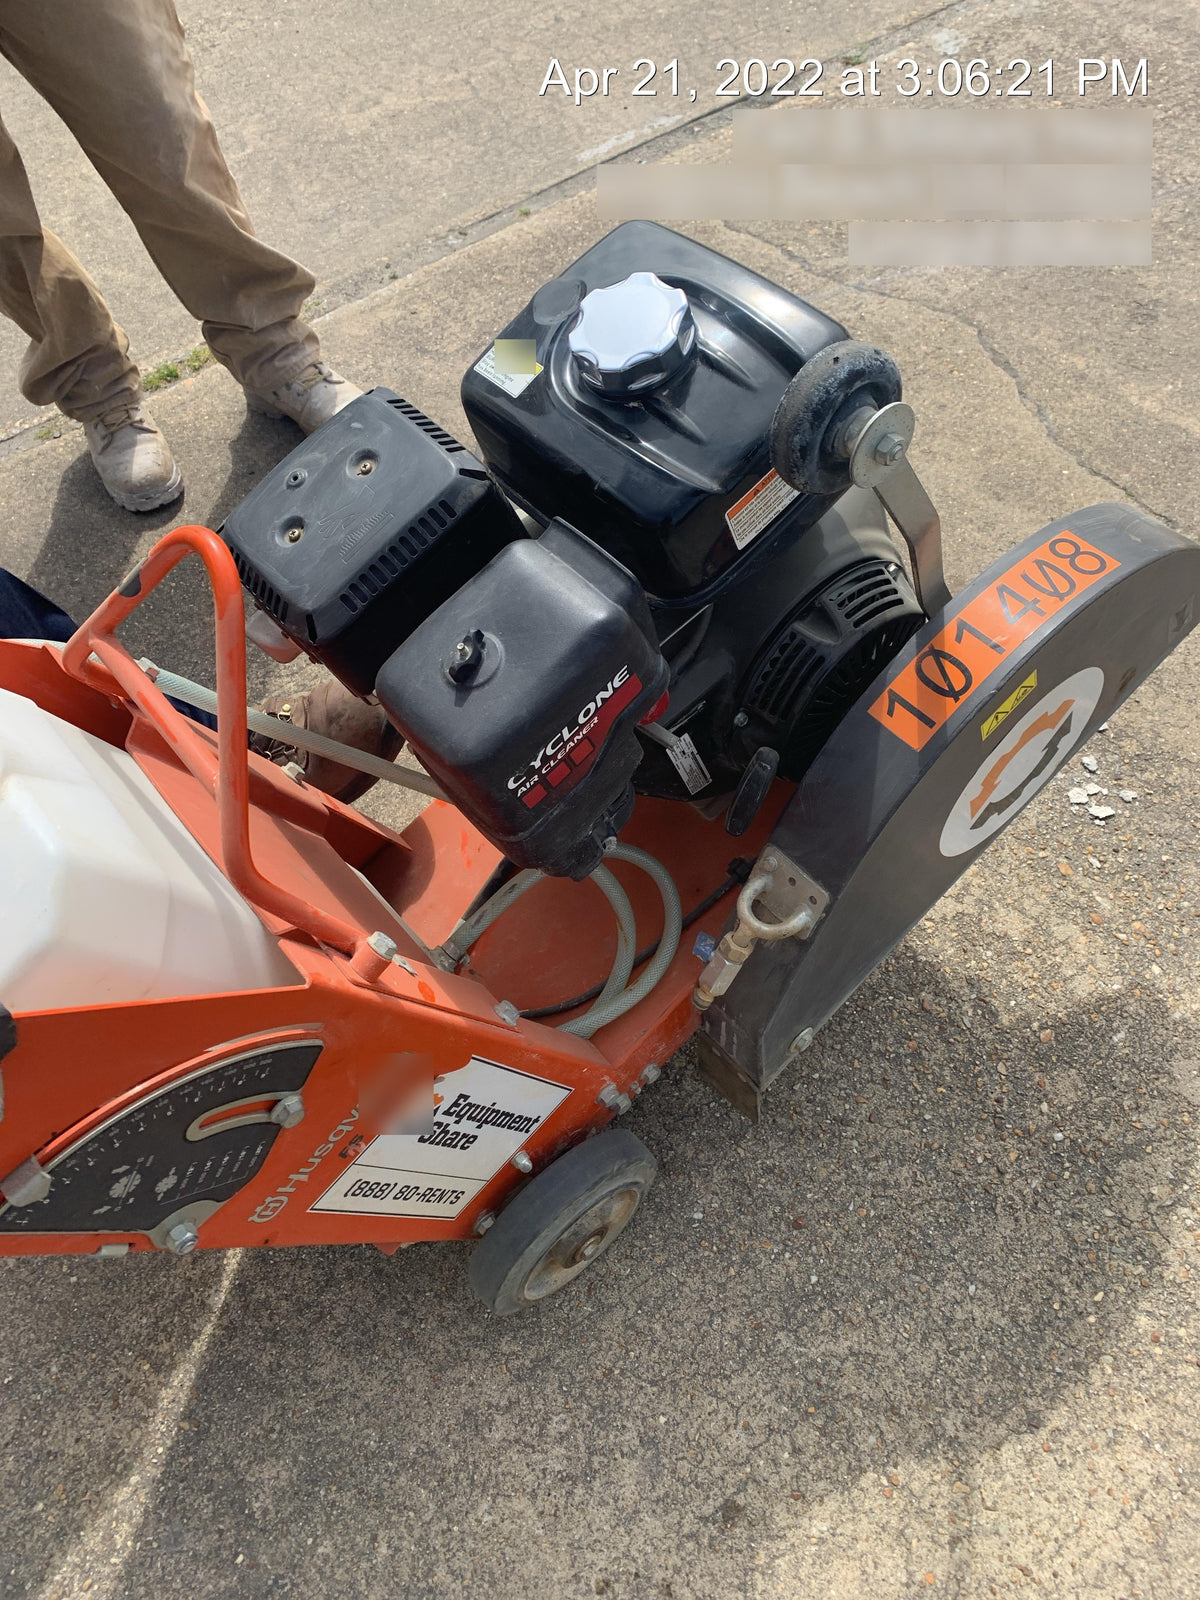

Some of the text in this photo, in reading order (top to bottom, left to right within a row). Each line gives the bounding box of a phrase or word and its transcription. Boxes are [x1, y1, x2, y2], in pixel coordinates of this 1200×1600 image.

[506, 664, 631, 791] CYCLONE
[516, 716, 600, 798] AIR CLEANER
[275, 1106, 359, 1193] Husqv
[442, 1093, 542, 1134] Equipment
[343, 1178, 466, 1206] (888) 80-RENTS
